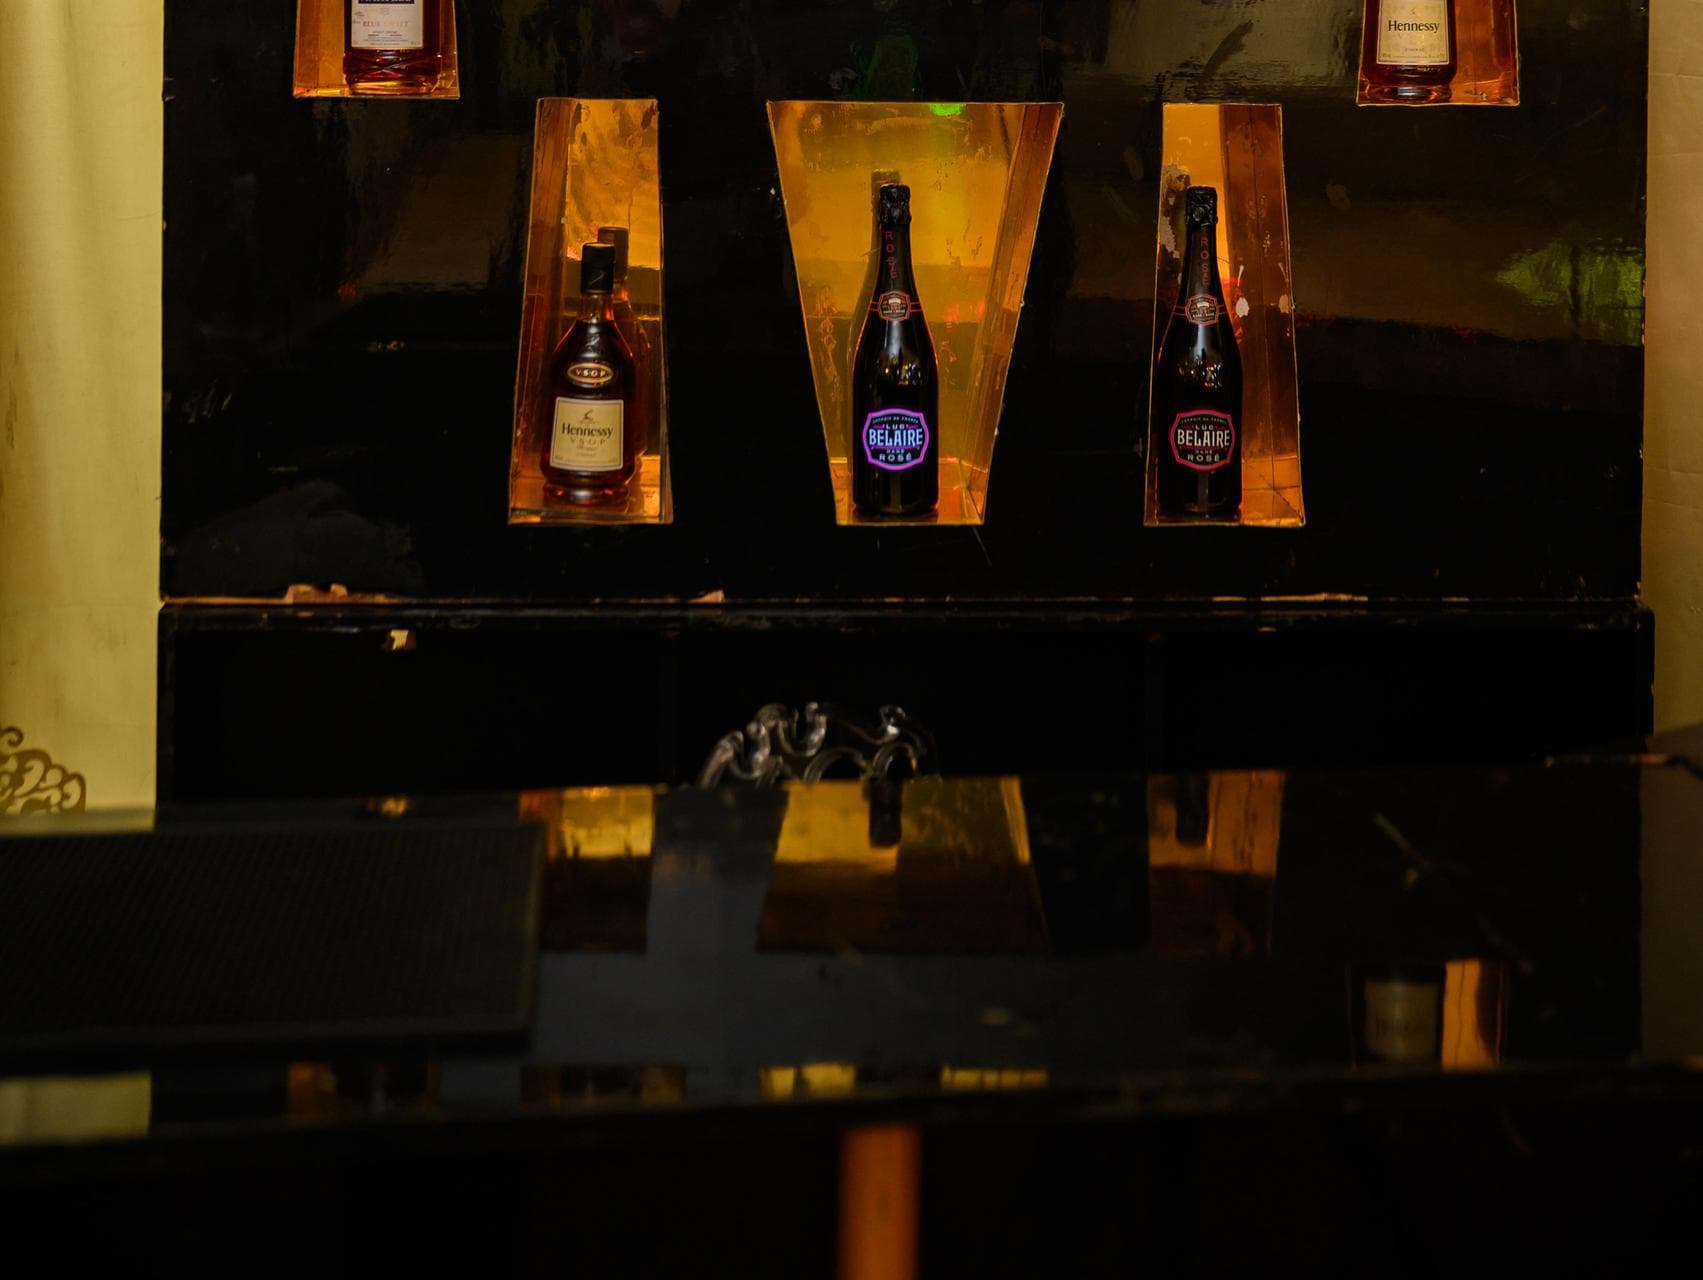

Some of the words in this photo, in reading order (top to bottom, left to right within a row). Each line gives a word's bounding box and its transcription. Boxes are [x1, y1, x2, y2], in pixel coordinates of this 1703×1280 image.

[1388, 19, 1441, 34] Hennessy
[561, 422, 613, 439] Hennessy
[869, 428, 924, 447] BELAIRE
[1177, 429, 1231, 448] BELAIRE
